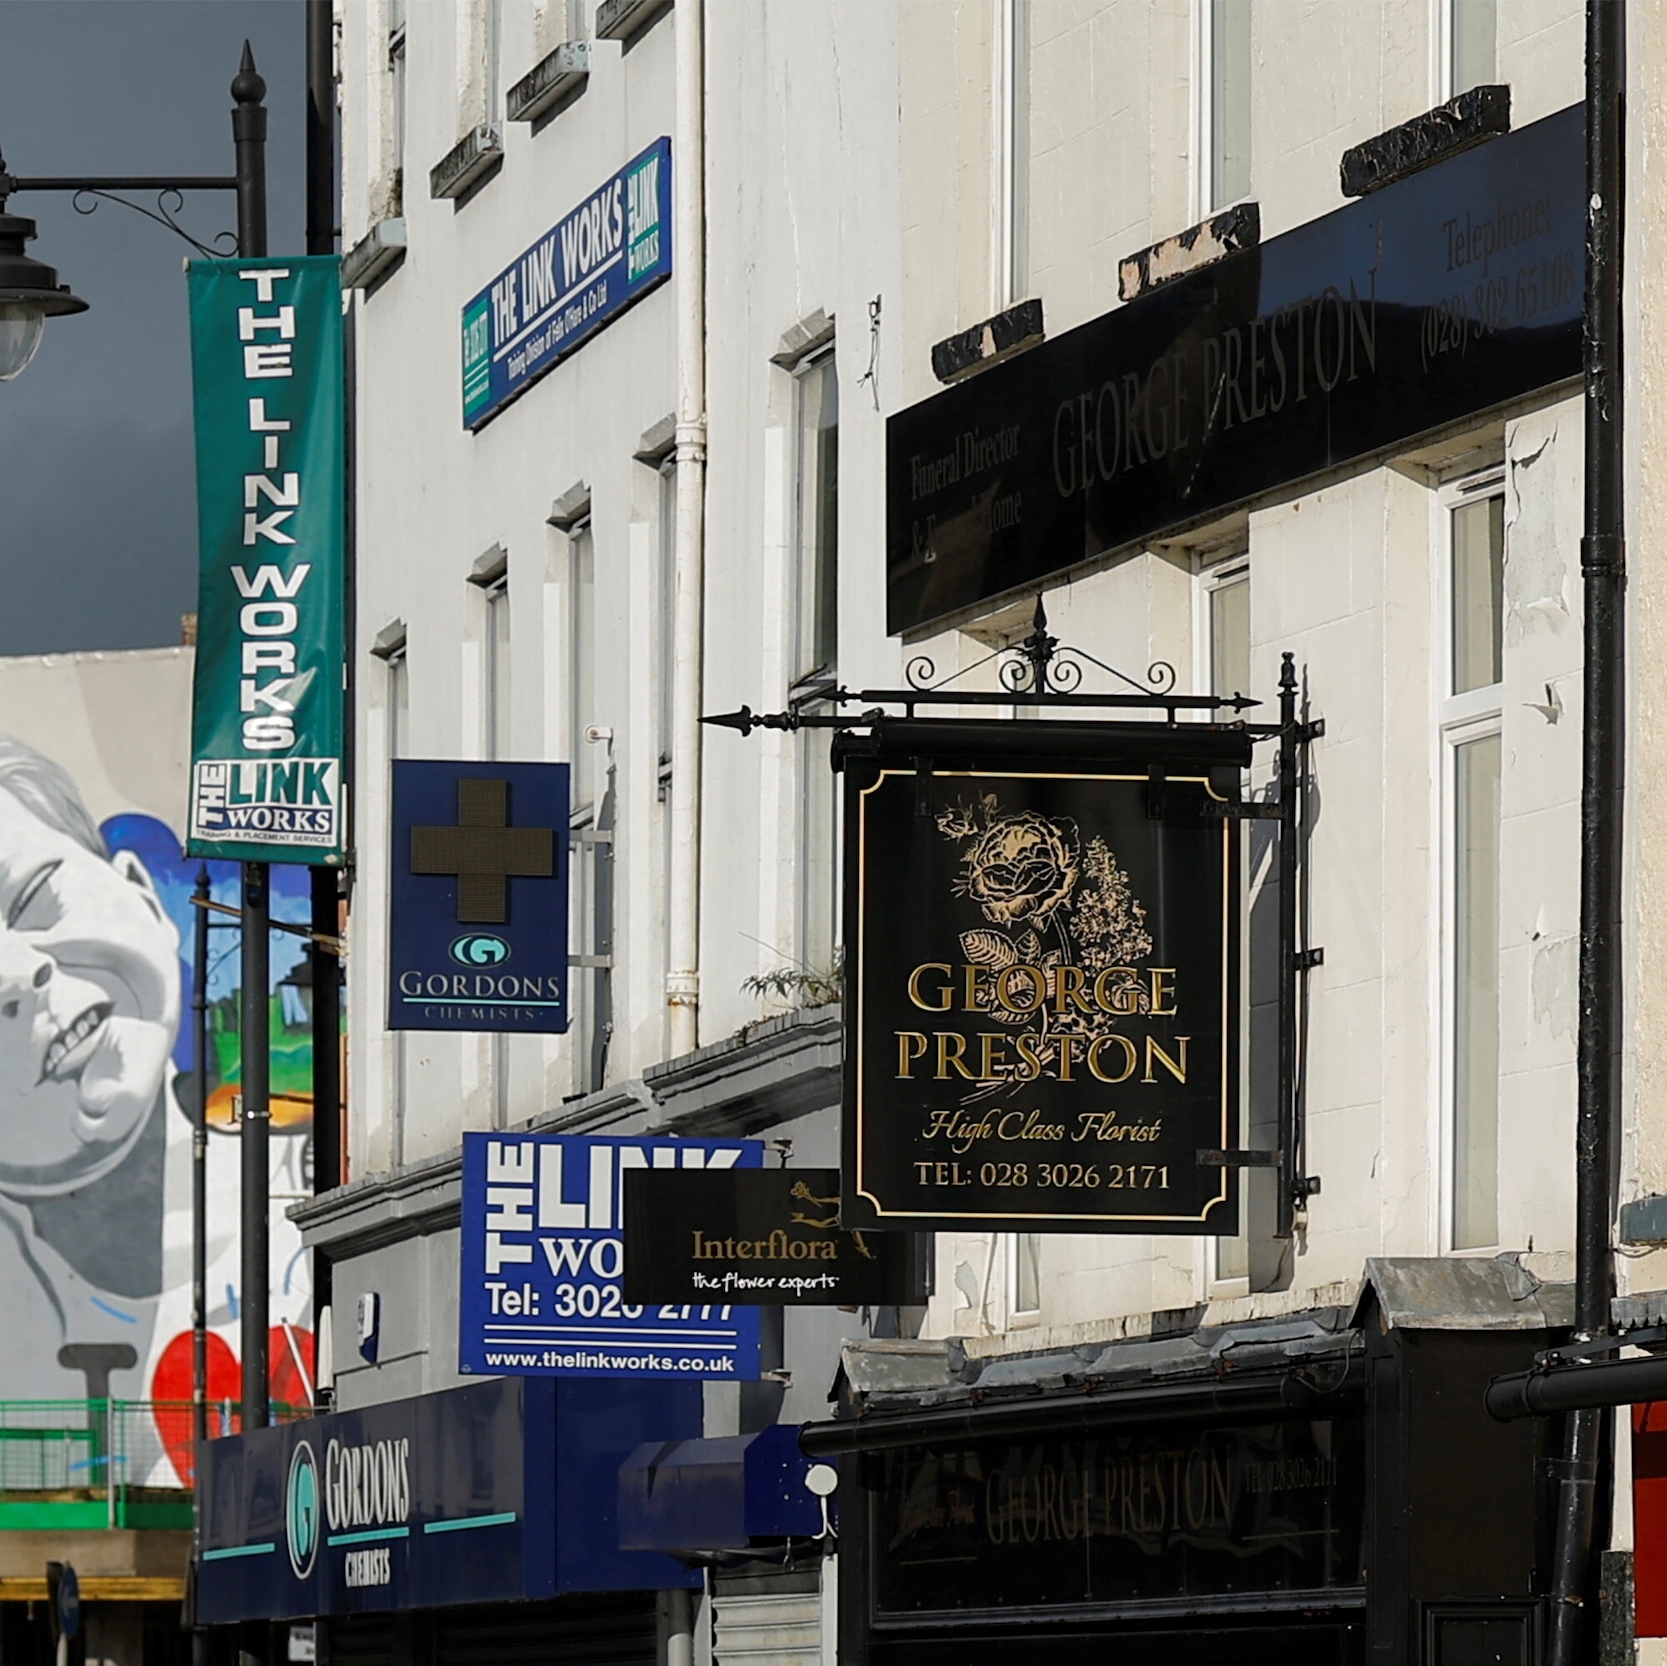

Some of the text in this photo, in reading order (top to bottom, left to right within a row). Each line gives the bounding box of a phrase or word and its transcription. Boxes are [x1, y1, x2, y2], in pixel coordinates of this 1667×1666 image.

[490, 269, 518, 348] THE
[521, 234, 557, 323] LINK
[561, 178, 623, 288] WORKS
[1052, 267, 1380, 498] GEORGE PRESTON
[910, 424, 1021, 502] Funeral Director
[229, 268, 312, 751] THE LINK WORKS
[198, 763, 226, 827] THE
[229, 761, 333, 805] LINK
[227, 808, 332, 833] WORKS
[244, 831, 290, 842] PLACEMENT
[293, 833, 332, 844] SERVICES
[399, 970, 561, 999] GORDONS
[907, 963, 1180, 1018] GEORGE
[425, 1007, 535, 1021] CHEMISTS
[894, 1031, 1192, 1085] PRESTON
[922, 1109, 1164, 1155] High Class Florist
[914, 1161, 1171, 1190] TEL: 028 3026 2171
[485, 1141, 534, 1275] THE
[692, 1229, 839, 1261] Interflora
[484, 1282, 539, 1316] Tel:
[691, 1271, 836, 1298] the flower experts
[485, 1350, 734, 1373] www.thelinkworks.co.uk
[325, 1437, 409, 1531] GORDONS
[1104, 1445, 1233, 1536] PRESTON
[344, 1547, 392, 1588] CHEMISTS
